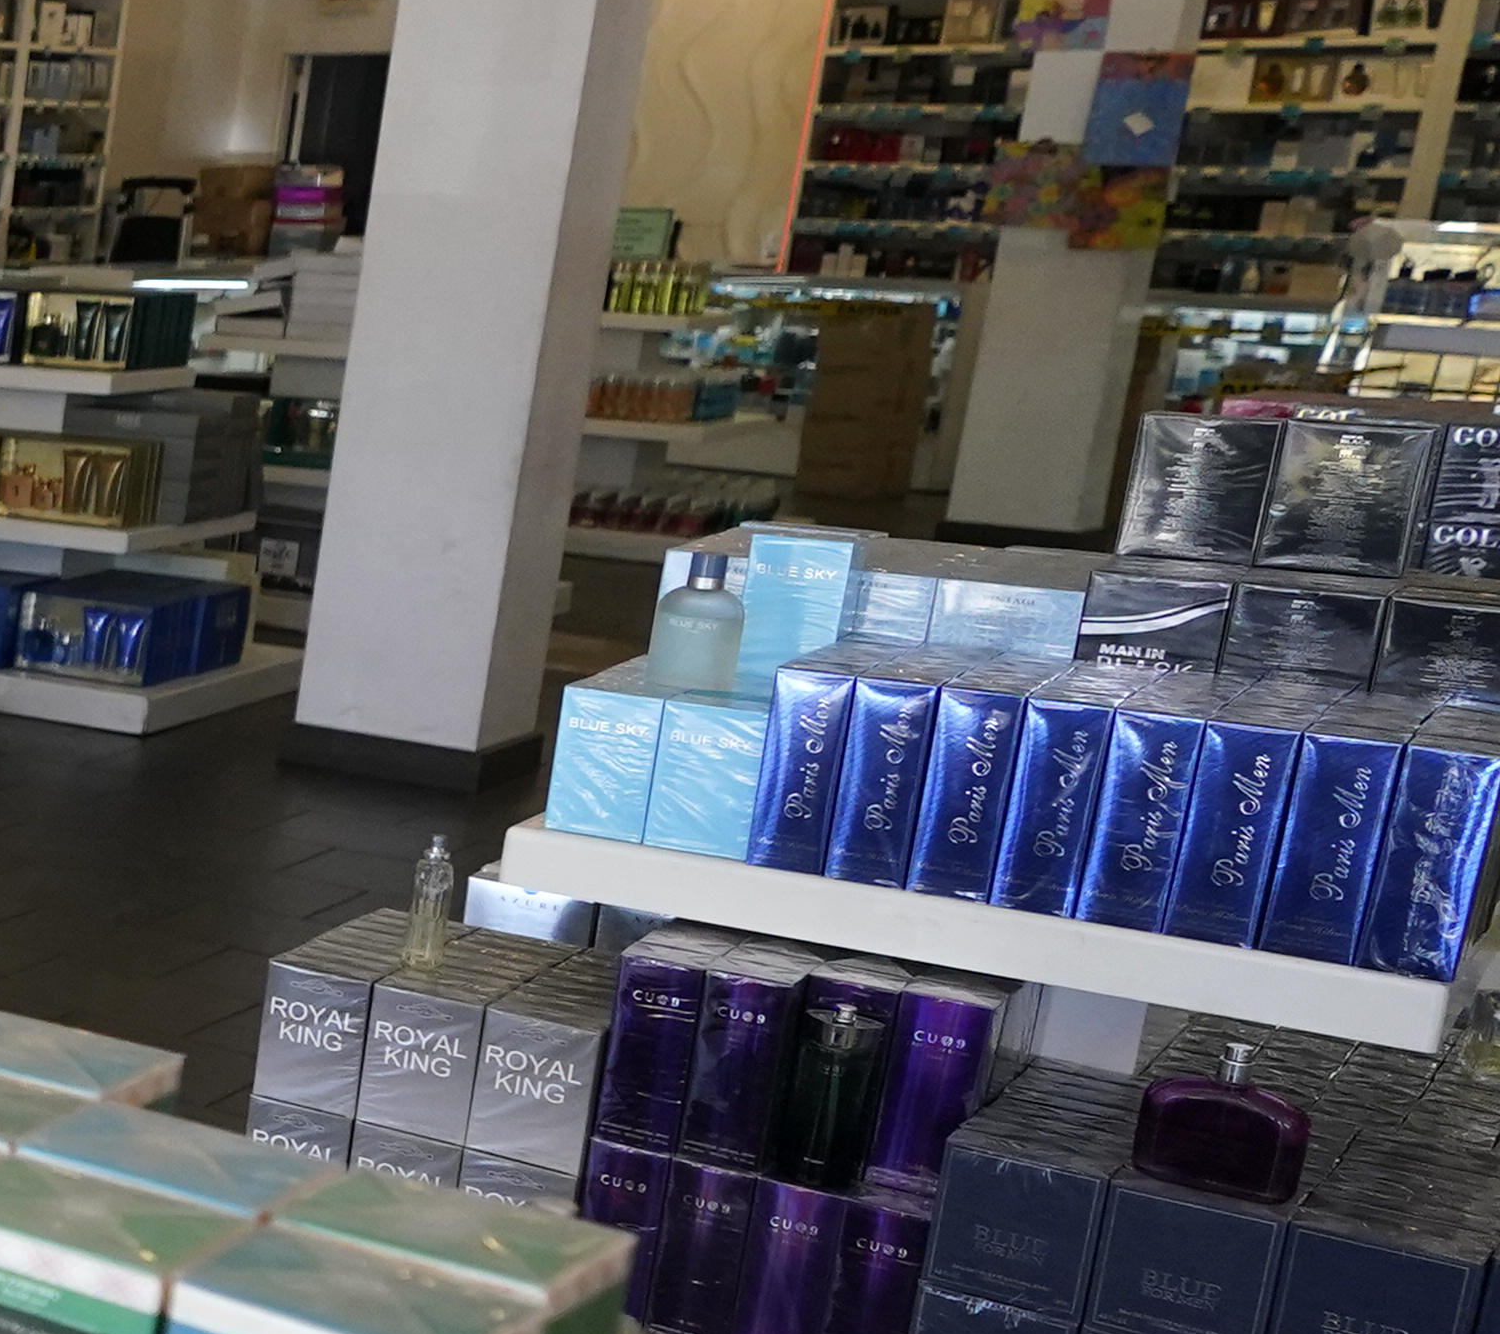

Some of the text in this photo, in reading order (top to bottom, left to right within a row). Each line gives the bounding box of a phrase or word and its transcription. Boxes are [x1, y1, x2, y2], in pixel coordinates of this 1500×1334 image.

[1434, 525, 1500, 549] GOL
[1098, 642, 1166, 660] MAN IN
[569, 716, 650, 738] BLUE SKY
[671, 730, 753, 751] BLUE SKY
[1212, 752, 1271, 889] Paris Men
[1309, 766, 1372, 903] Paris Men
[270, 995, 359, 1034] ROYAL
[278, 1021, 344, 1053] KING
[374, 1020, 468, 1060] ROYAL
[384, 1046, 453, 1079] KING
[484, 1044, 584, 1087] ROYAL
[494, 1070, 566, 1105] KING
